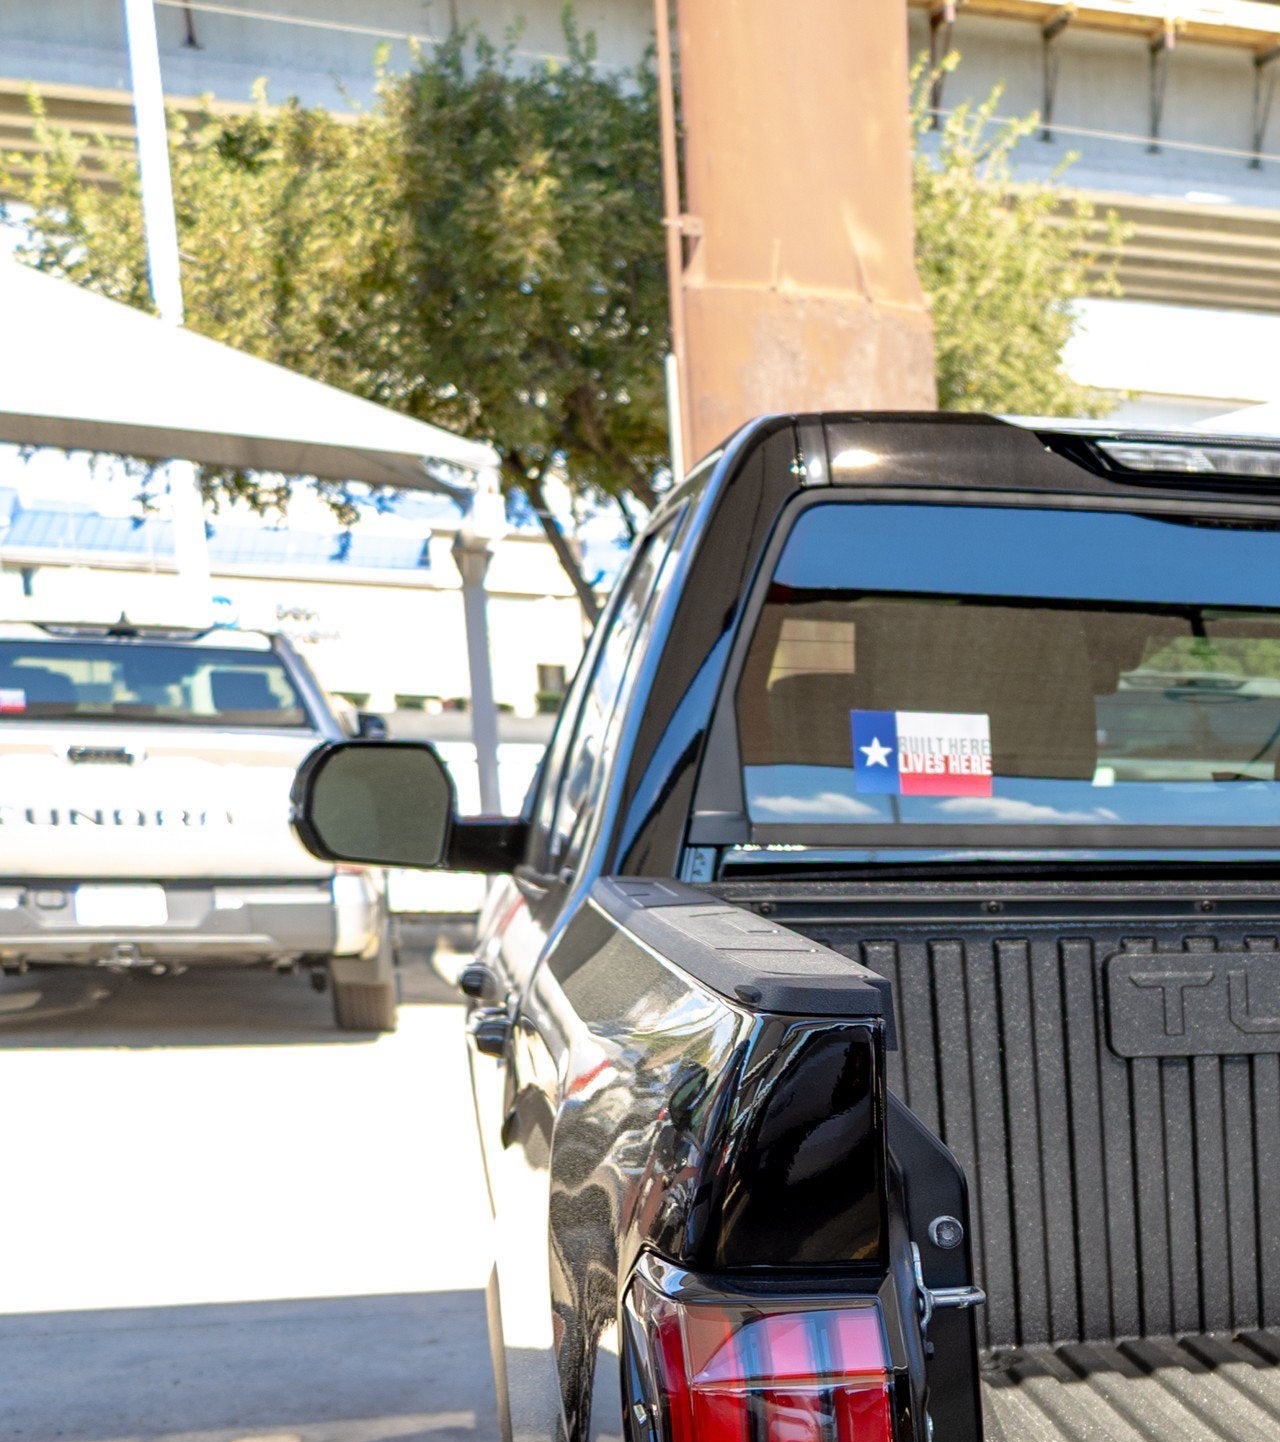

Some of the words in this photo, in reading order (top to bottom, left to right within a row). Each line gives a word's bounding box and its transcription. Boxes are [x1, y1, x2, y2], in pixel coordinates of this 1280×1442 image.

[898, 736, 943, 754] BUILT
[948, 738, 992, 757] HERE
[899, 753, 946, 774] LIVES
[949, 755, 993, 776] HERE
